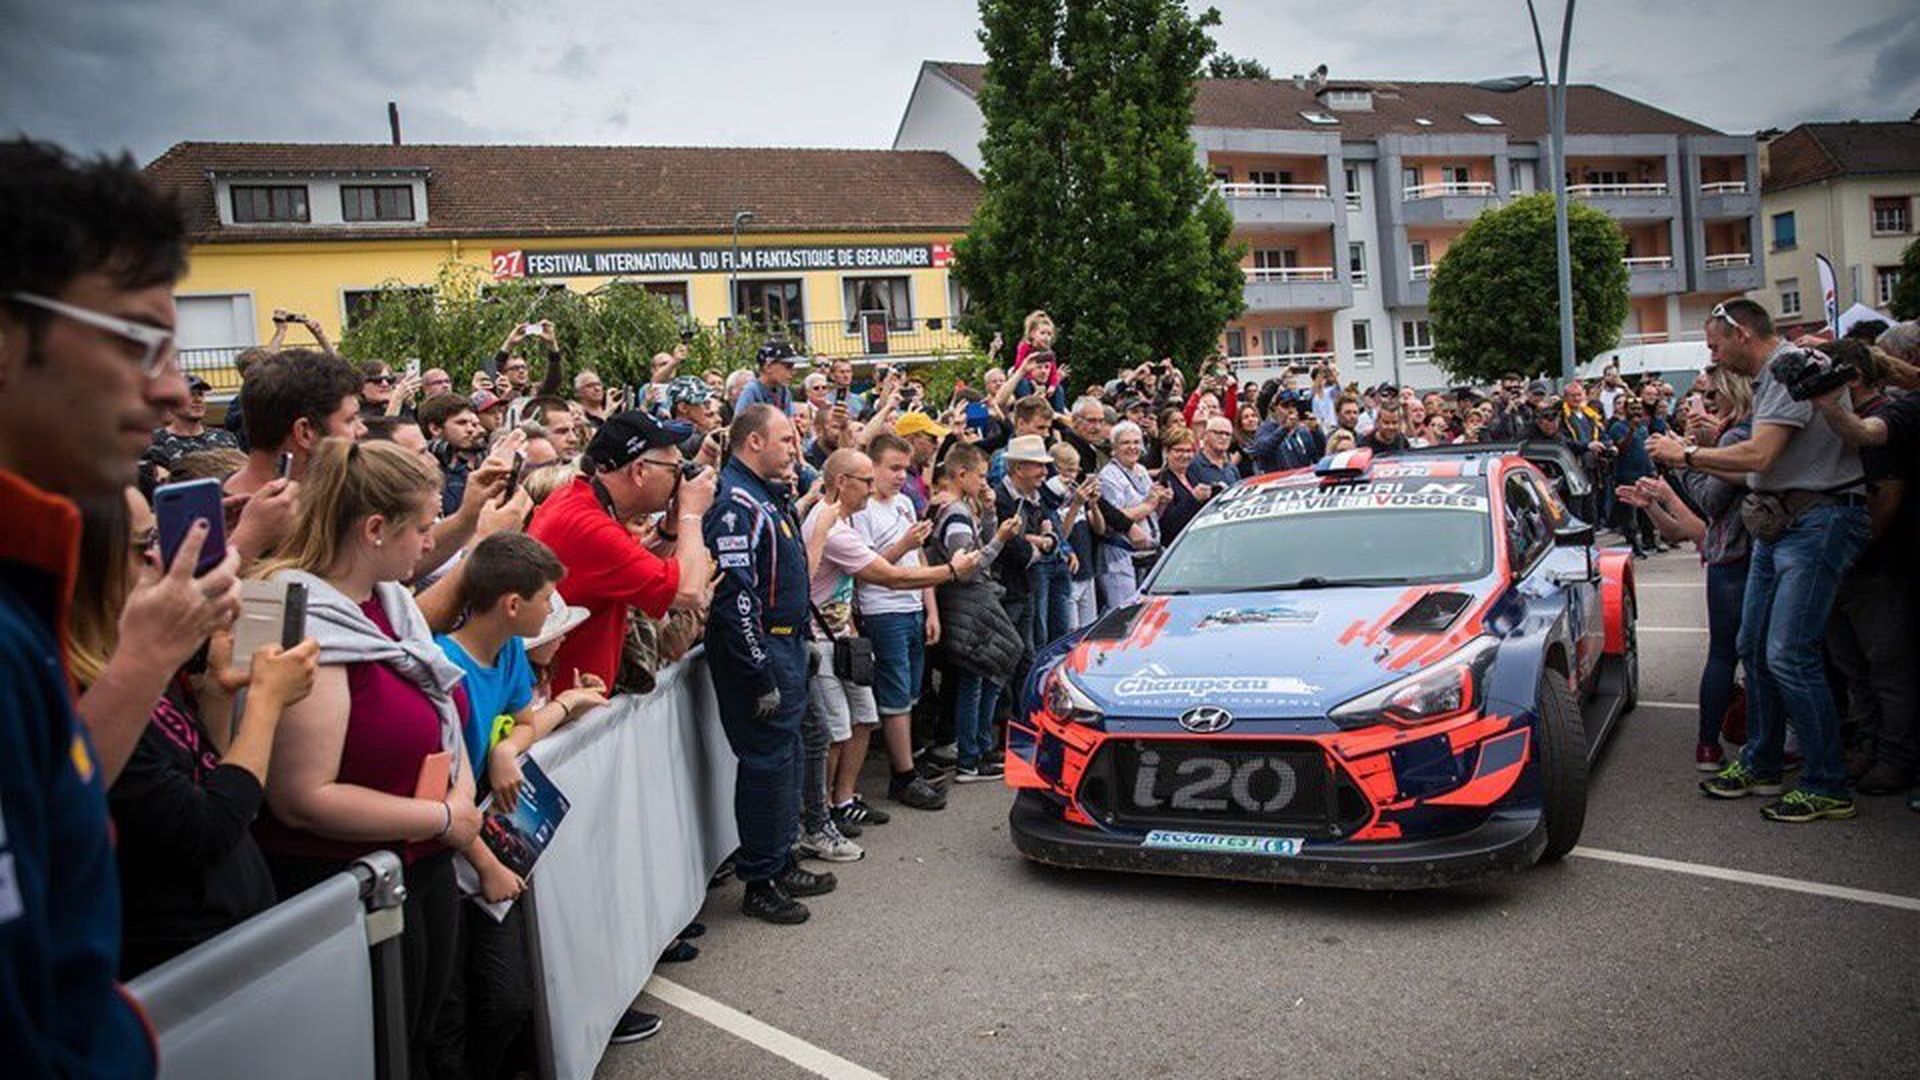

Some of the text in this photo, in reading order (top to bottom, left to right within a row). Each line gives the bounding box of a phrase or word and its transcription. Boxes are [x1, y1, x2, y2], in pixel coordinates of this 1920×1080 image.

[492, 250, 524, 277] 27
[528, 253, 592, 274] FESTIVAL
[595, 251, 697, 272] INTERNATIONAL
[700, 251, 718, 269] DU
[756, 248, 835, 268] FANTASTIQUE
[838, 248, 854, 266] DE
[857, 247, 929, 266] GERARDMER
[1276, 483, 1404, 502] HYUNDAI
[1375, 494, 1477, 507] VOSGES
[1117, 676, 1270, 695] Champeau
[1133, 751, 1297, 812] i20
